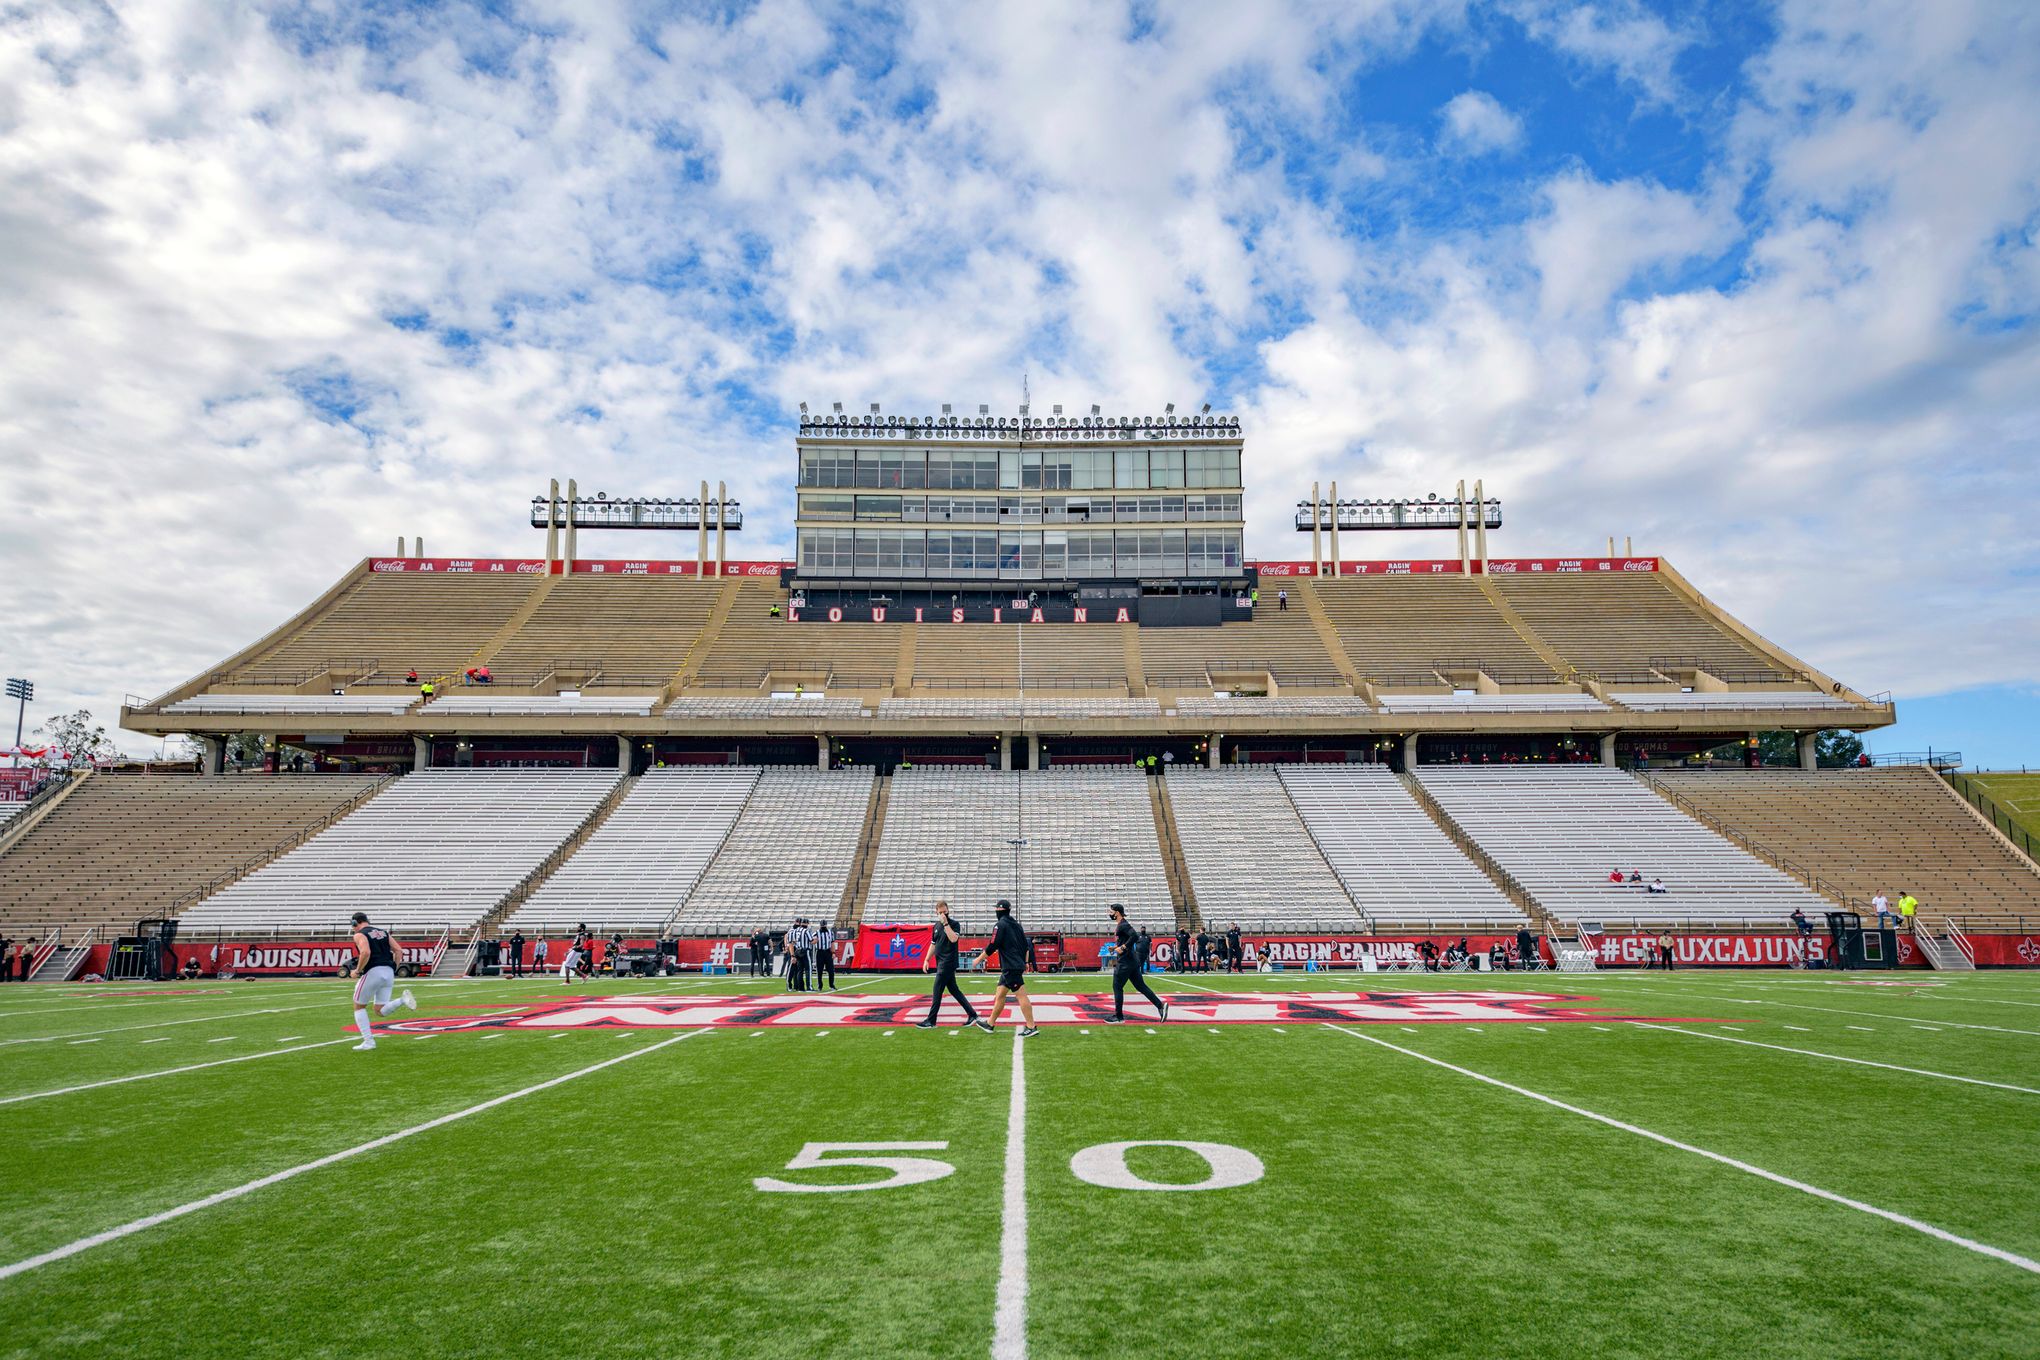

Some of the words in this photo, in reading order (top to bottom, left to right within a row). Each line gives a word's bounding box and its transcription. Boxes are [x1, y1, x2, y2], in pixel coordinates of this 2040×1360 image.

[420, 562, 434, 570] AA
[728, 566, 739, 574] CC
[1012, 600, 1027, 608] DD
[1237, 599, 1252, 607] EE
[1633, 742, 1668, 751] THOMAS
[875, 944, 922, 958] LHC
[1270, 940, 1338, 960] RAGIN'
[1340, 943, 1415, 961] CAJUNS
[232, 948, 354, 968] LOUISIANA
